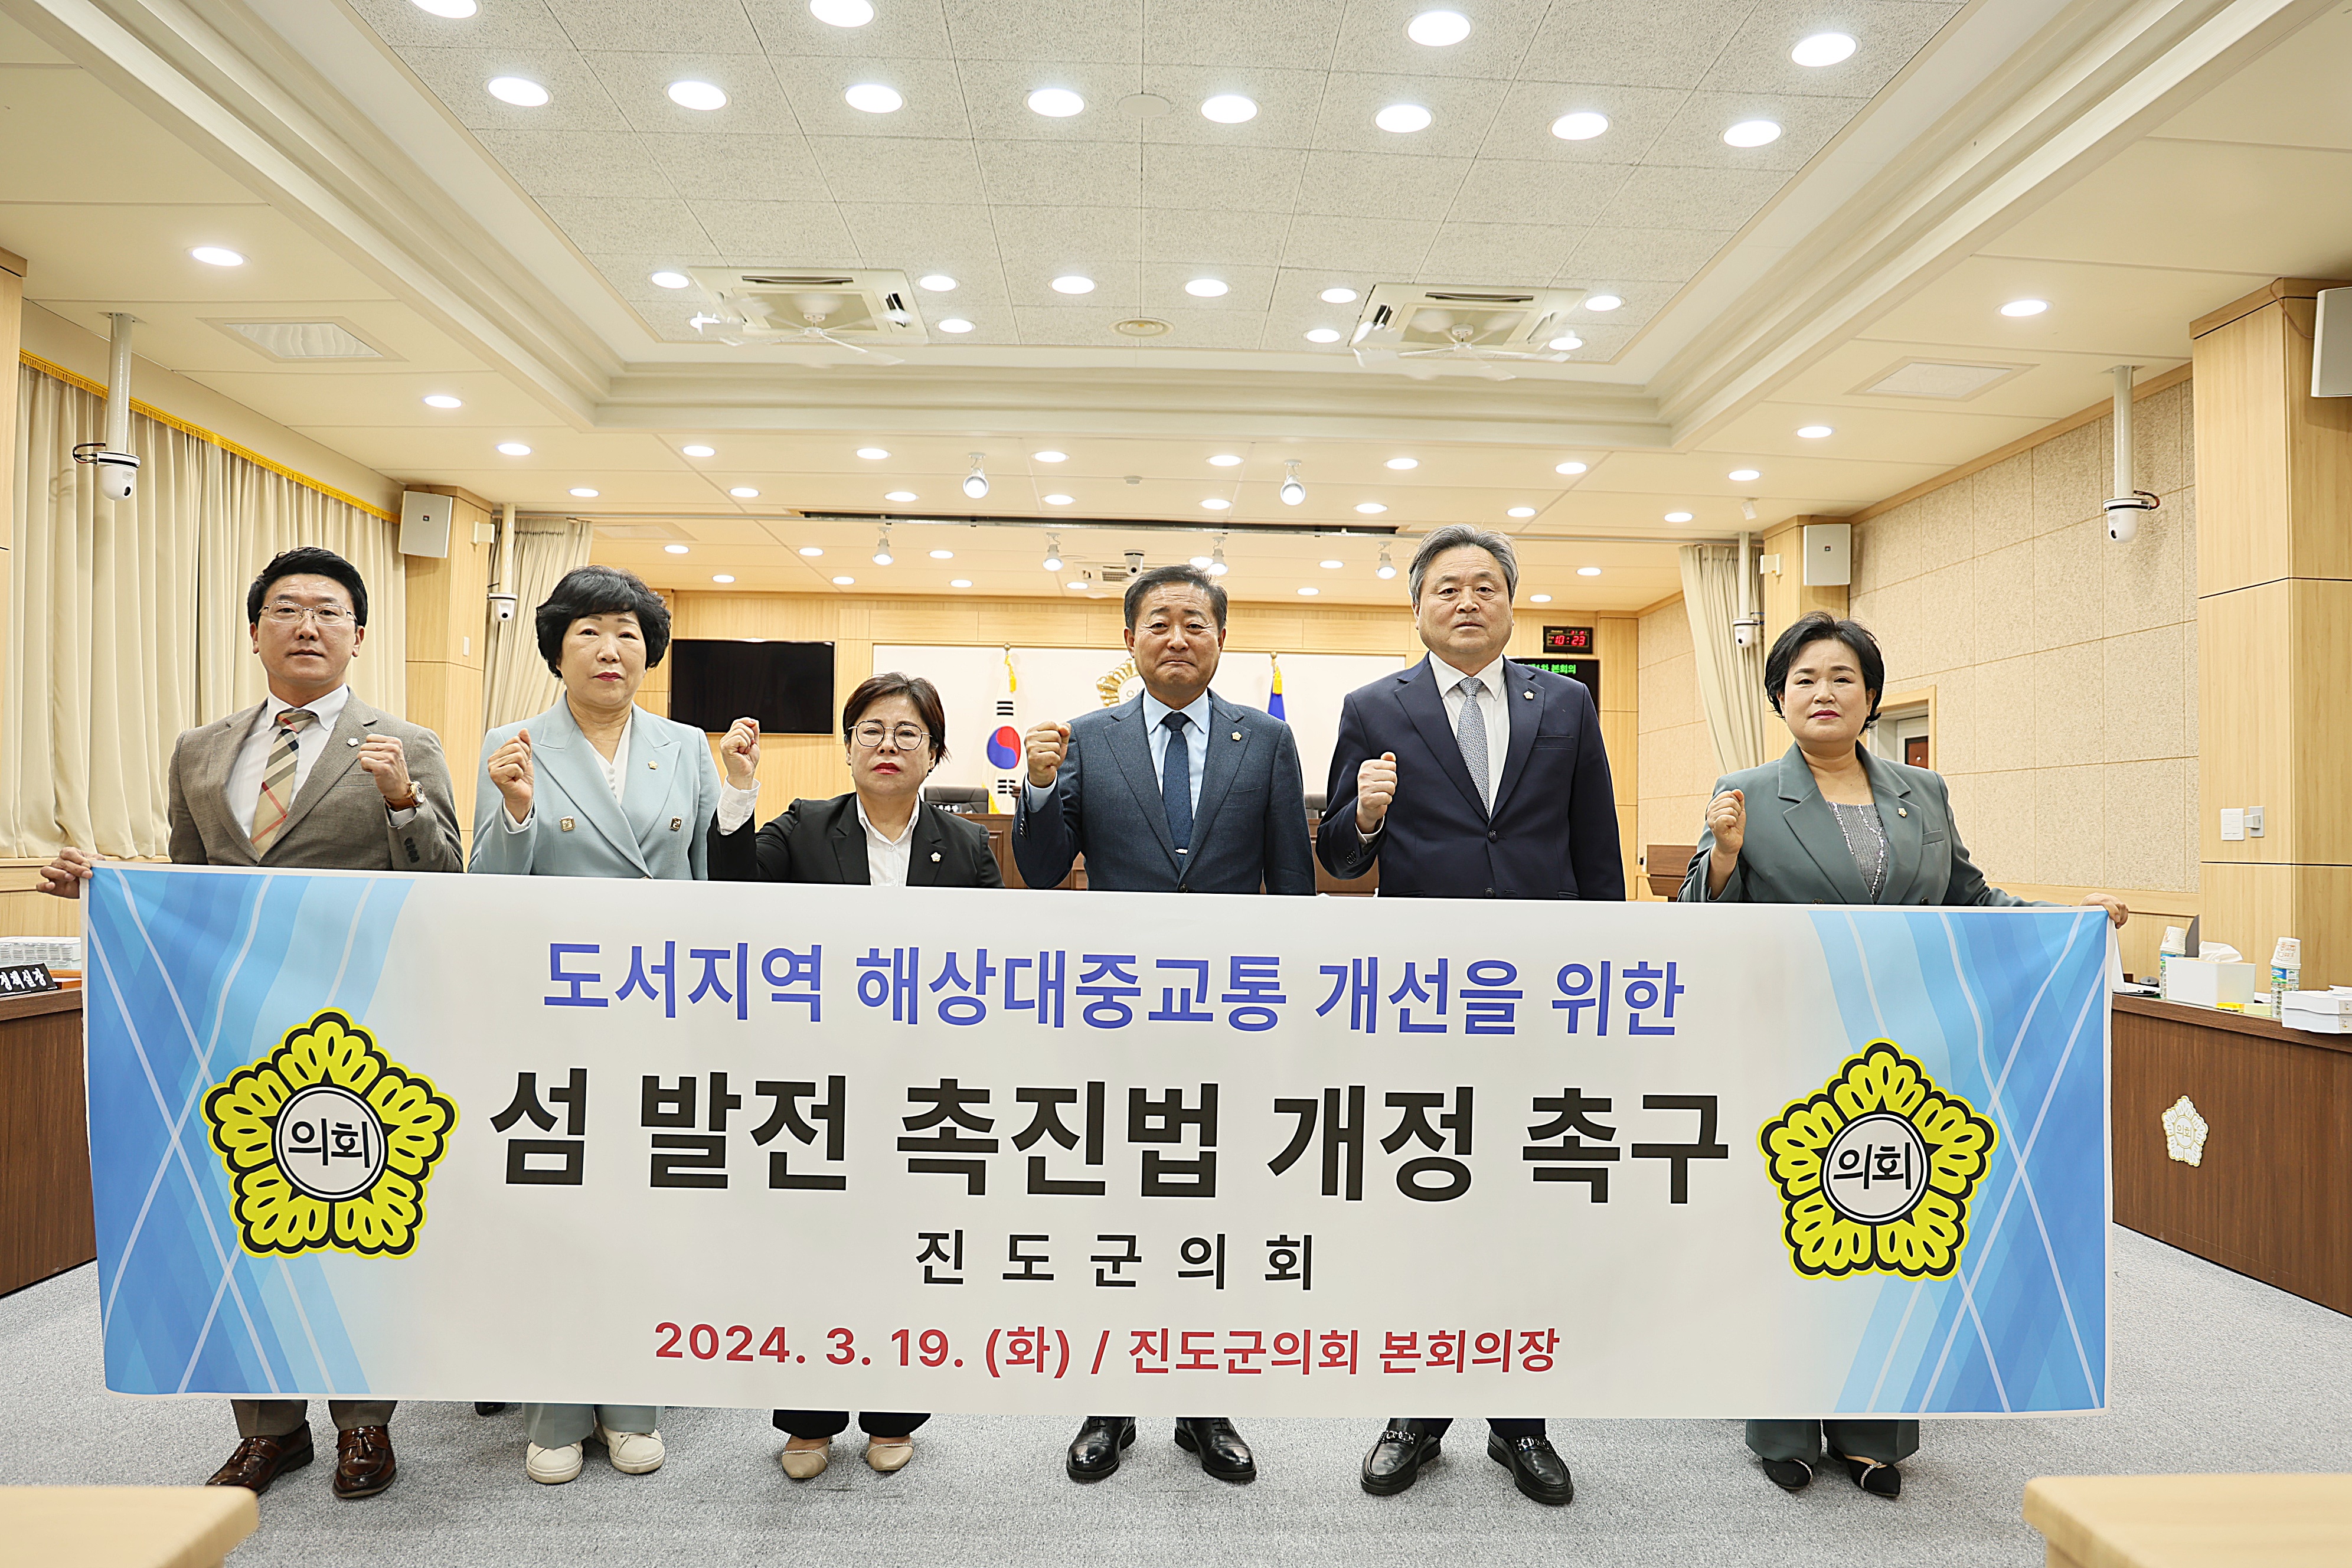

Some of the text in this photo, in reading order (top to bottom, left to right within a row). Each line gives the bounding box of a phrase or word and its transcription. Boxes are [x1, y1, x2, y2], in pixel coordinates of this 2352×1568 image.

[1554, 635, 1586, 646] 10:23
[1551, 664, 1576, 674] 본회의
[544, 940, 1685, 1037] 도서지역 해상대중교통 개선을 위한
[288, 1118, 371, 1169] 의회
[489, 1067, 1729, 1205] 섬 발전 촉진법 개정 촉구
[1833, 1142, 1912, 1190] 의회
[655, 1322, 806, 1364] 2024.
[825, 1327, 871, 1366] 3.
[891, 1328, 964, 1368] 19.
[985, 1325, 1070, 1379] (화)
[1129, 1327, 1358, 1376] 진도군의회
[1378, 1327, 1560, 1374] 본회의장
